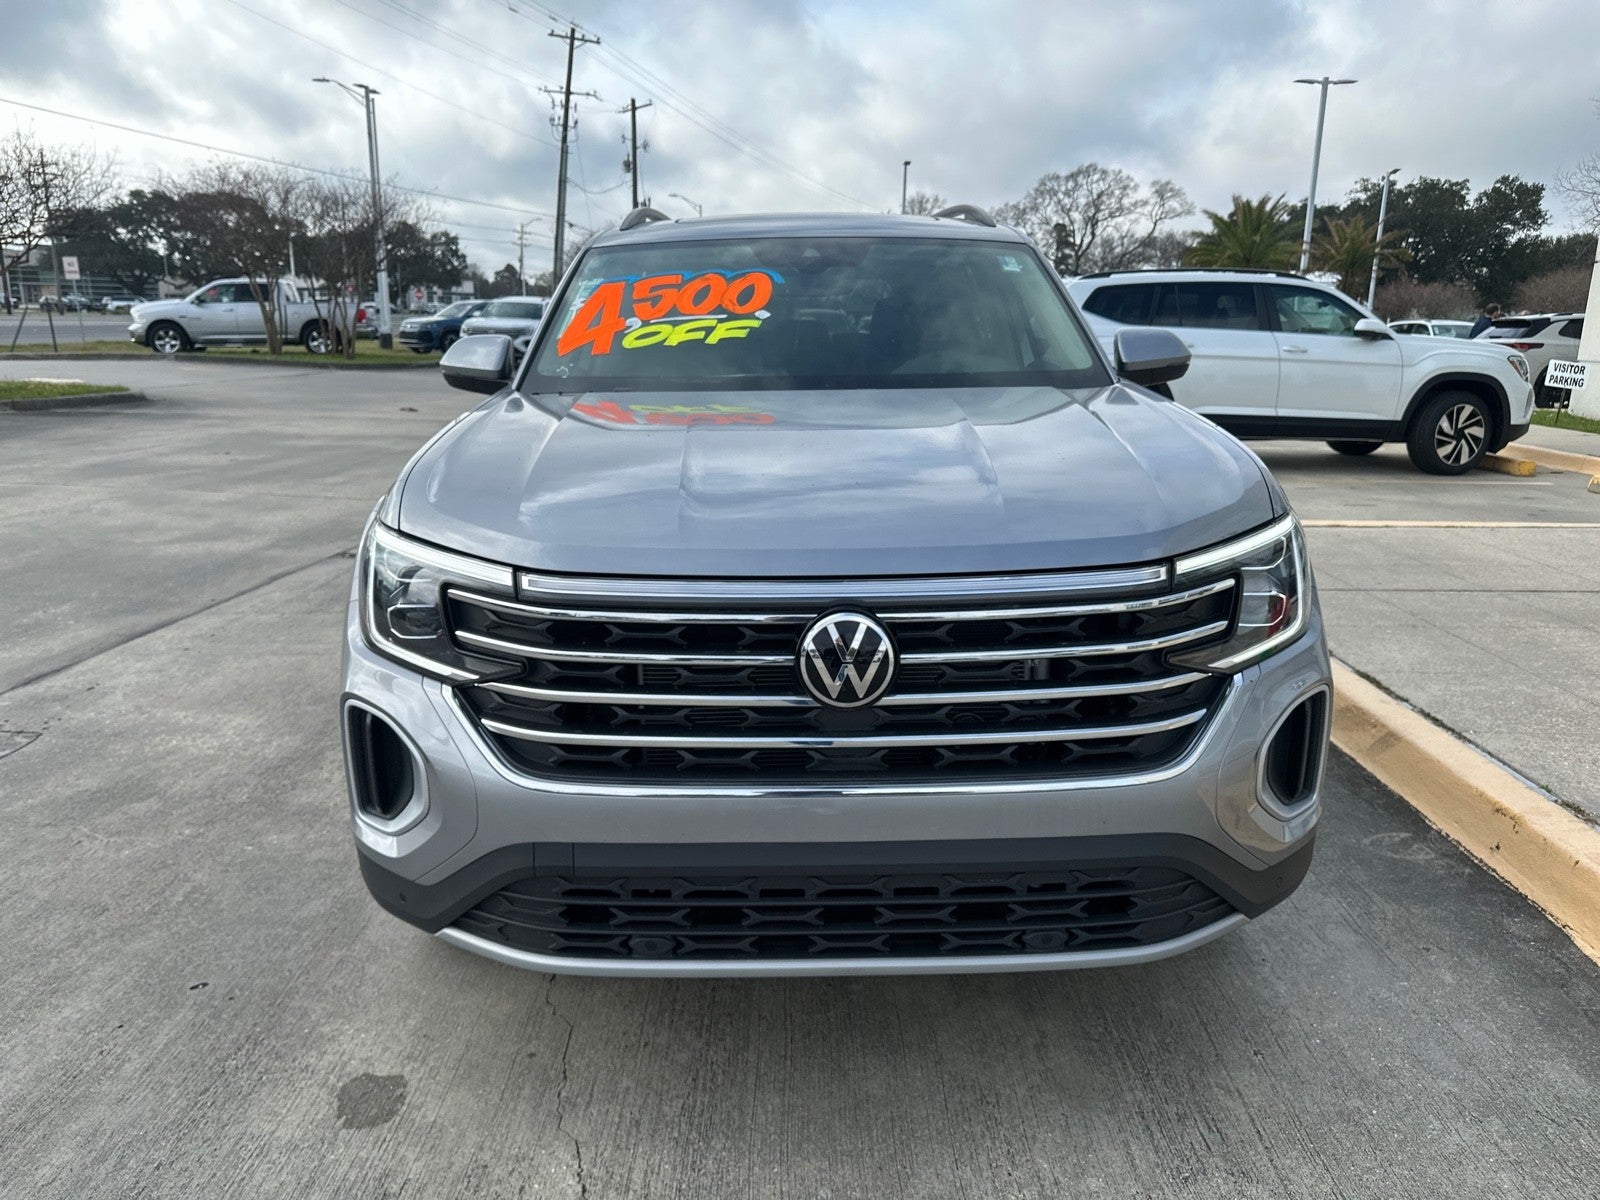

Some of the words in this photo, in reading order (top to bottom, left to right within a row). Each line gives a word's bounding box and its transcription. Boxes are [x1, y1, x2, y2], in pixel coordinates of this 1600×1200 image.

[622, 319, 762, 349] OFF
[1553, 362, 1586, 375] VISITOR
[1549, 374, 1585, 388] PARKING
